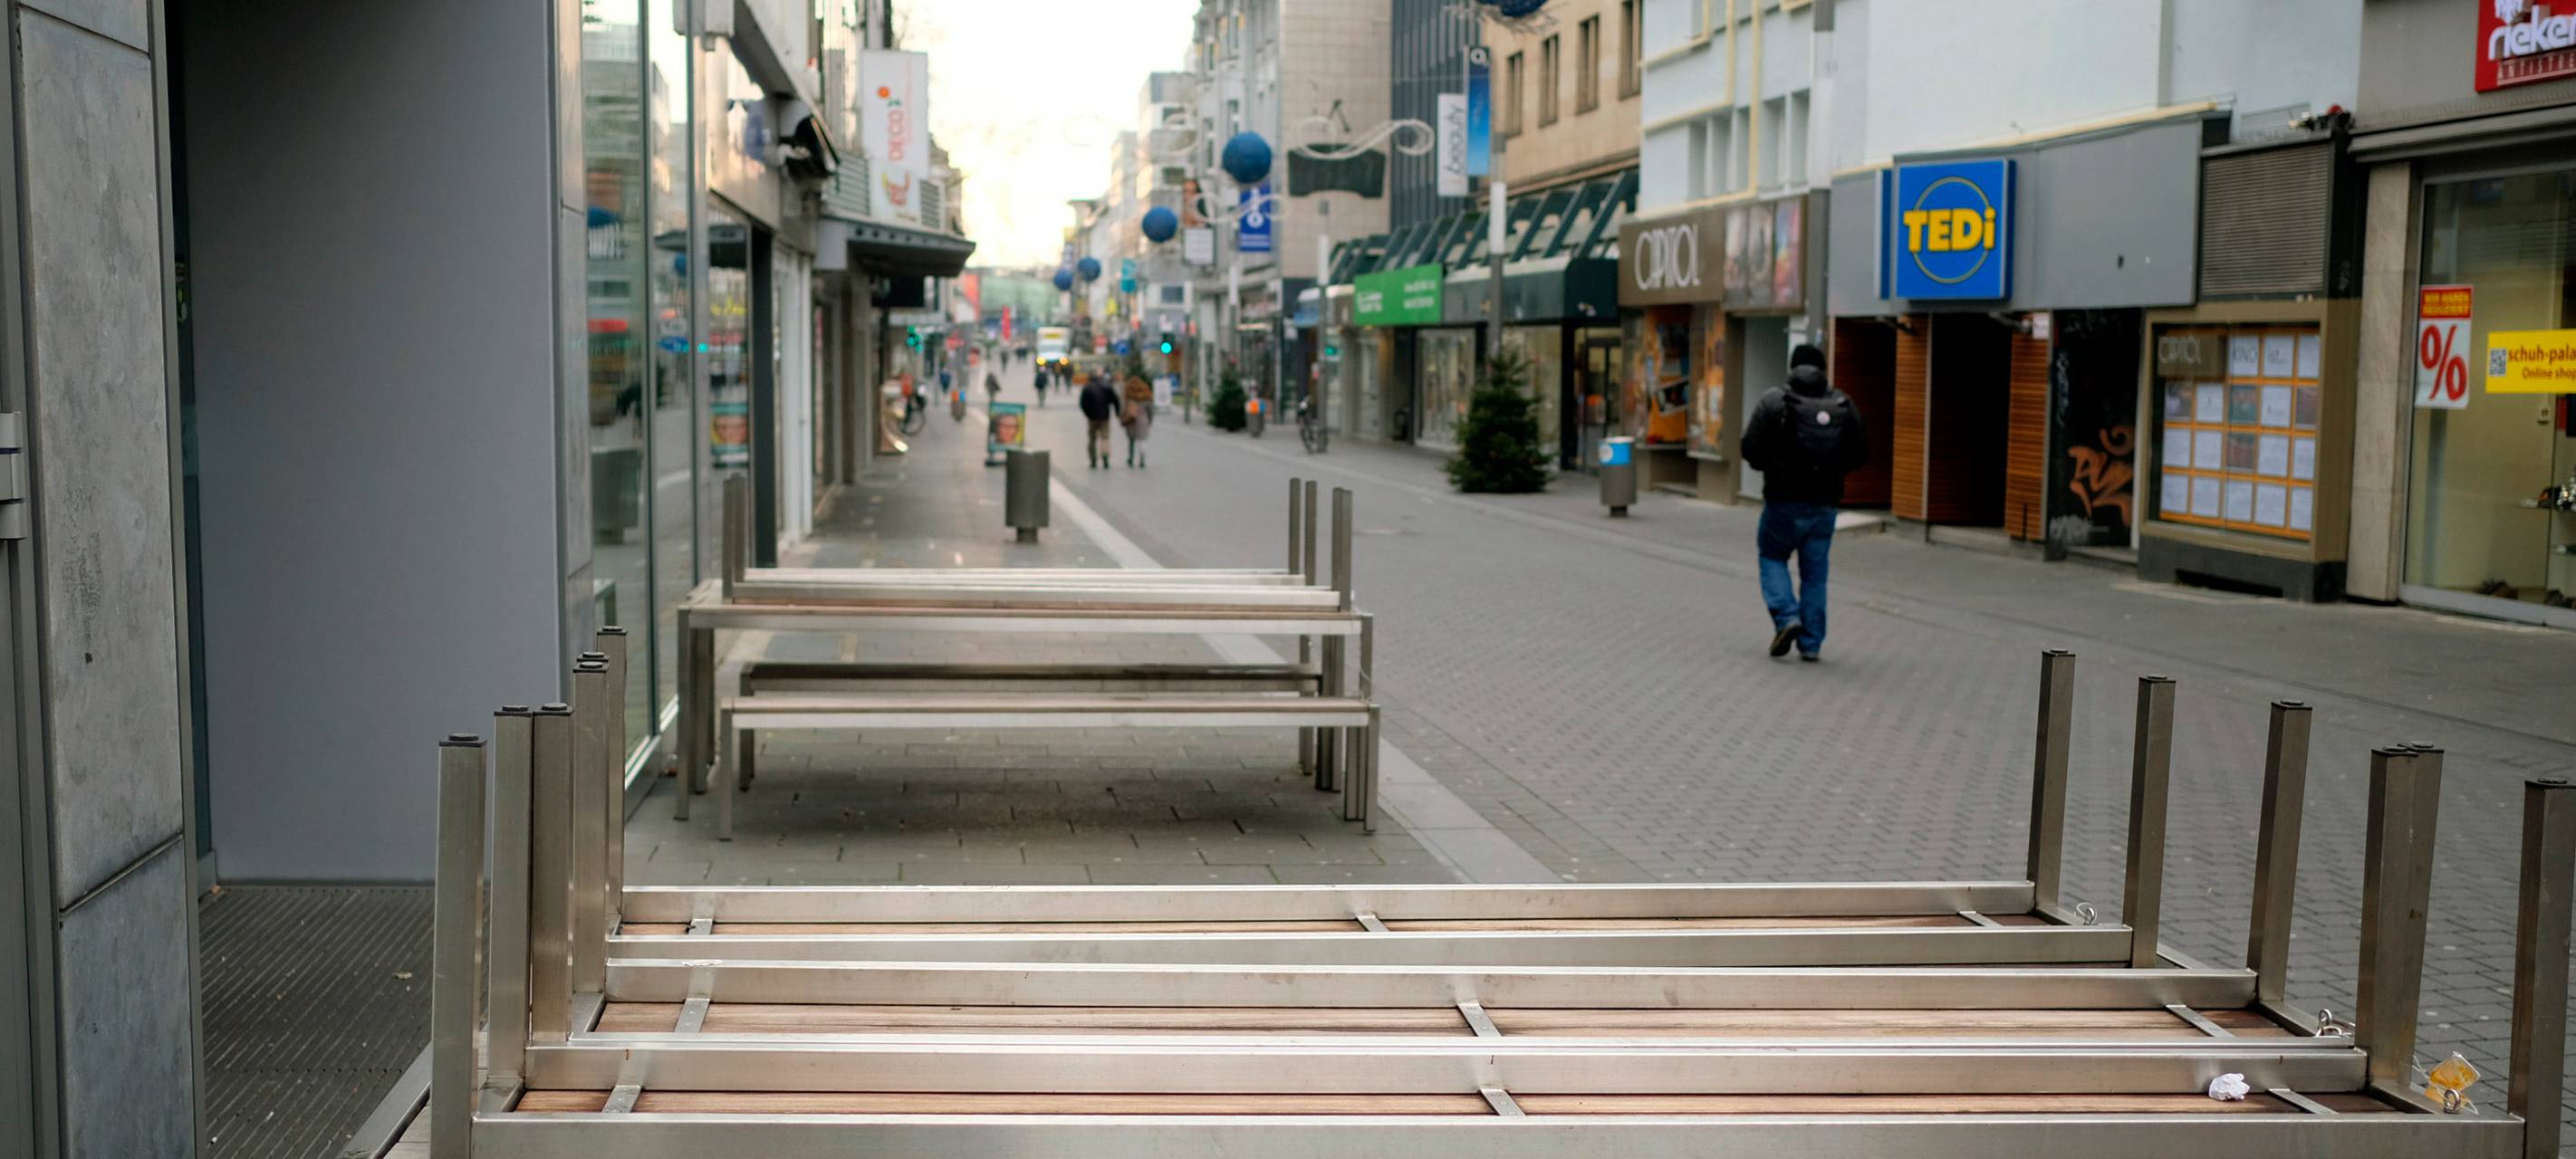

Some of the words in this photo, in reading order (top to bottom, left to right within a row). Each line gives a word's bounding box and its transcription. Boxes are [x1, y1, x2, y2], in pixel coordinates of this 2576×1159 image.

[887, 109, 905, 161] DECO
[1444, 104, 1465, 176] beauty
[1903, 206, 1997, 253] TEDi
[2507, 343, 2576, 366] schuh-pala
[2522, 367, 2553, 379] Online
